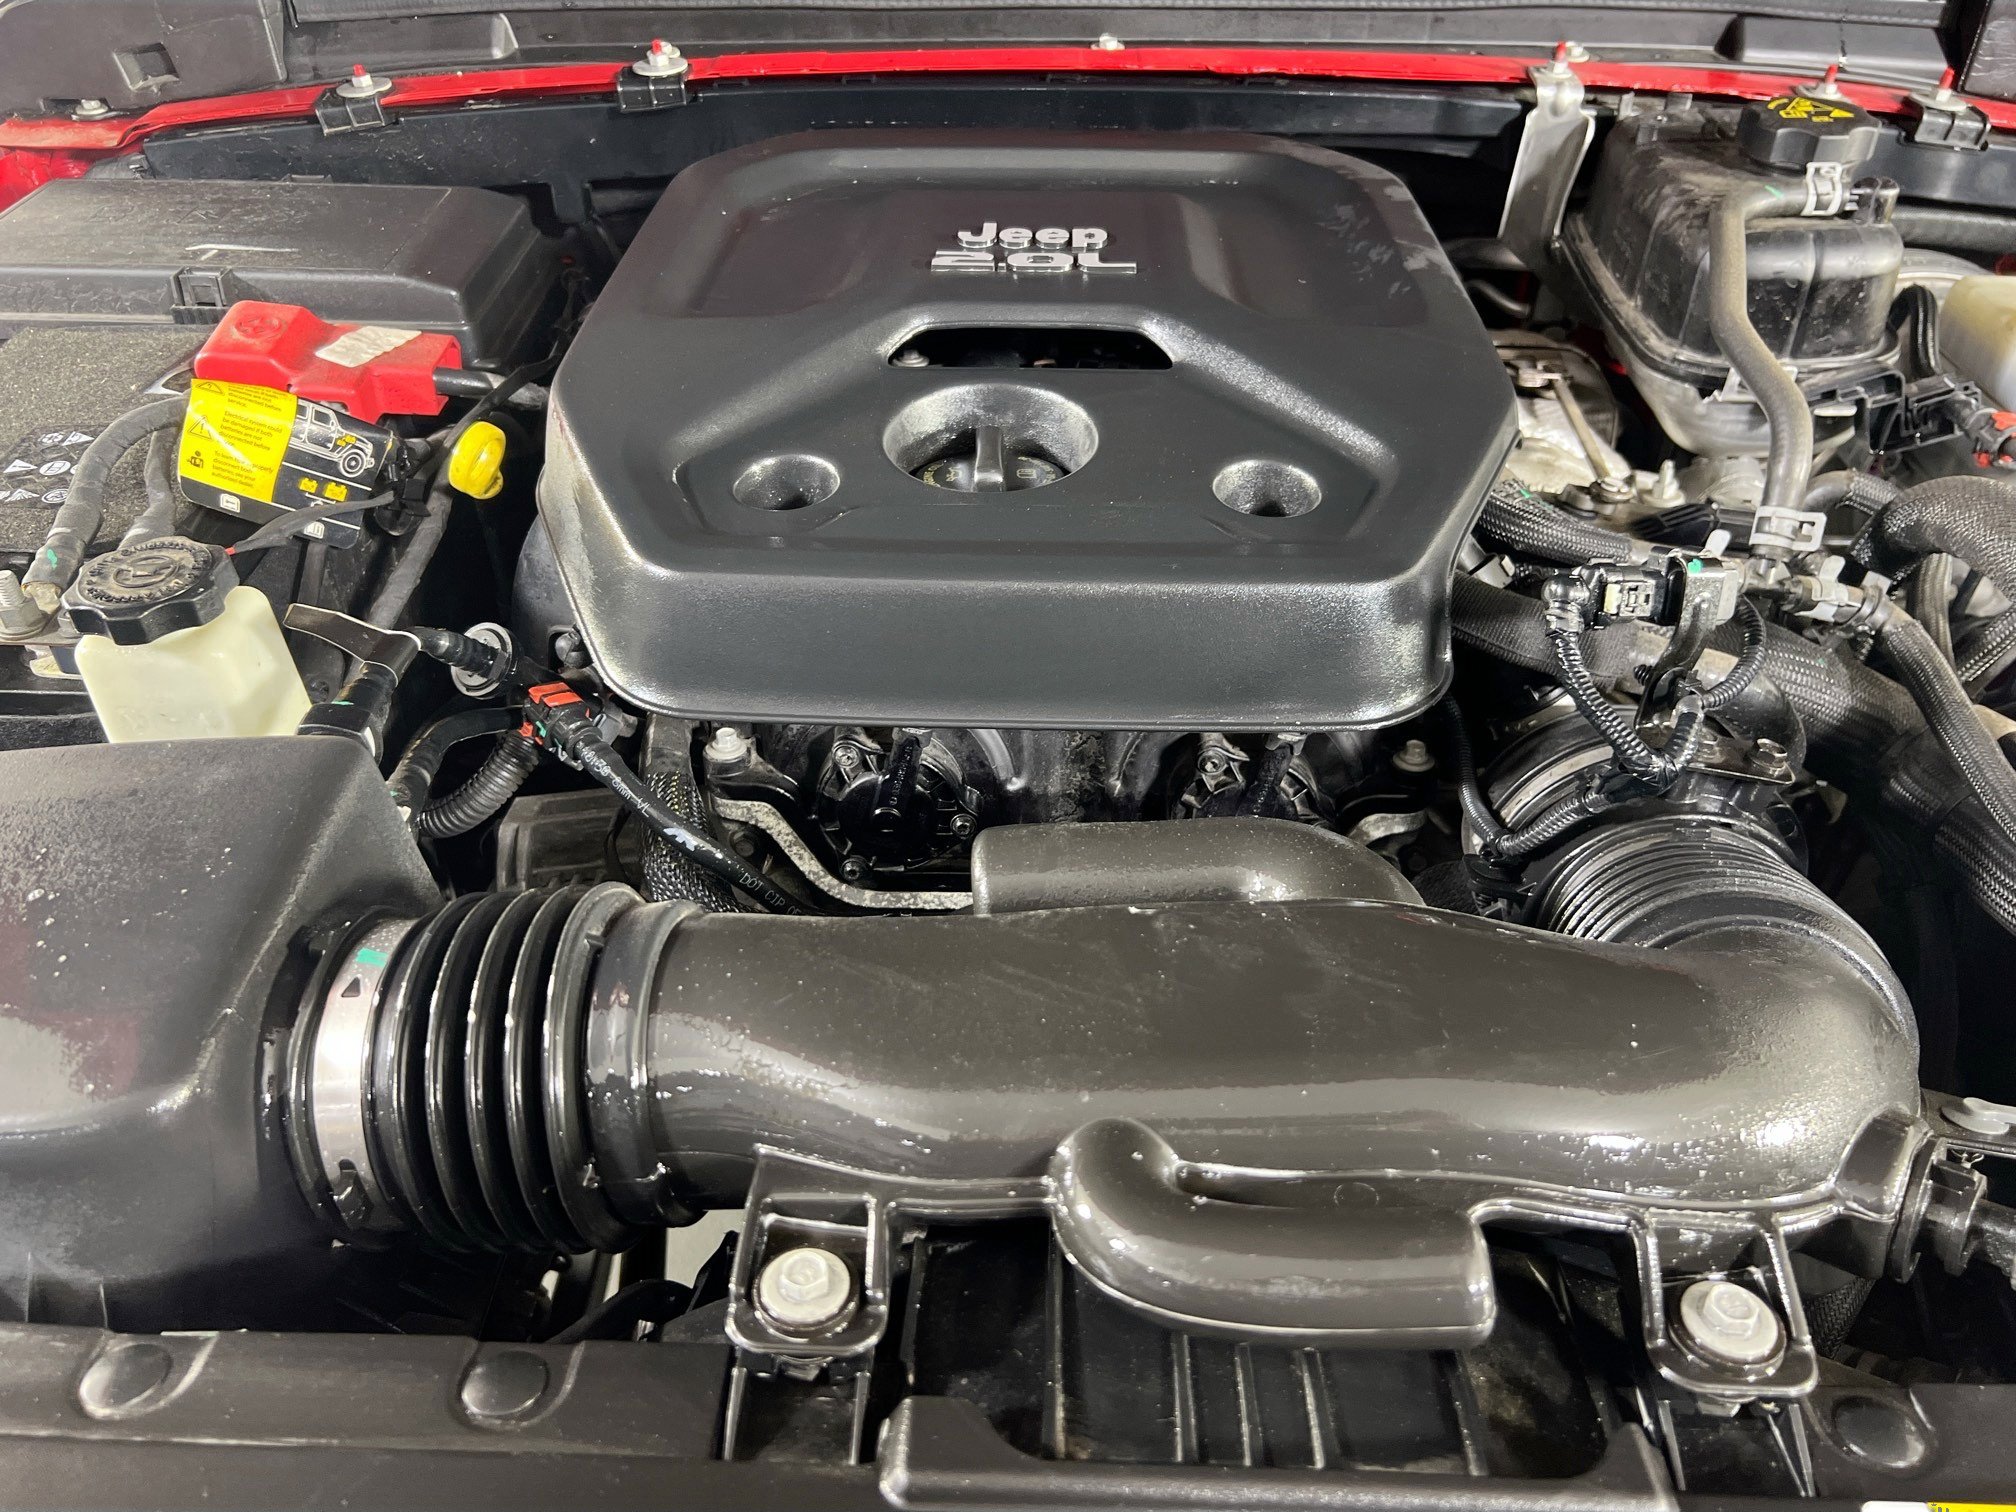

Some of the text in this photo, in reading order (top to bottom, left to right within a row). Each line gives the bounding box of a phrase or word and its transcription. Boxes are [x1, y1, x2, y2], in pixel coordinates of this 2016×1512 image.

[957, 222, 1108, 253] Jeep
[931, 250, 1137, 274] 2.0L
[220, 424, 243, 435] batteries
[224, 411, 282, 434] Electrical system could
[231, 420, 255, 431] damaged
[260, 429, 273, 438] both
[254, 441, 270, 450] before
[739, 872, 764, 891] DOT
